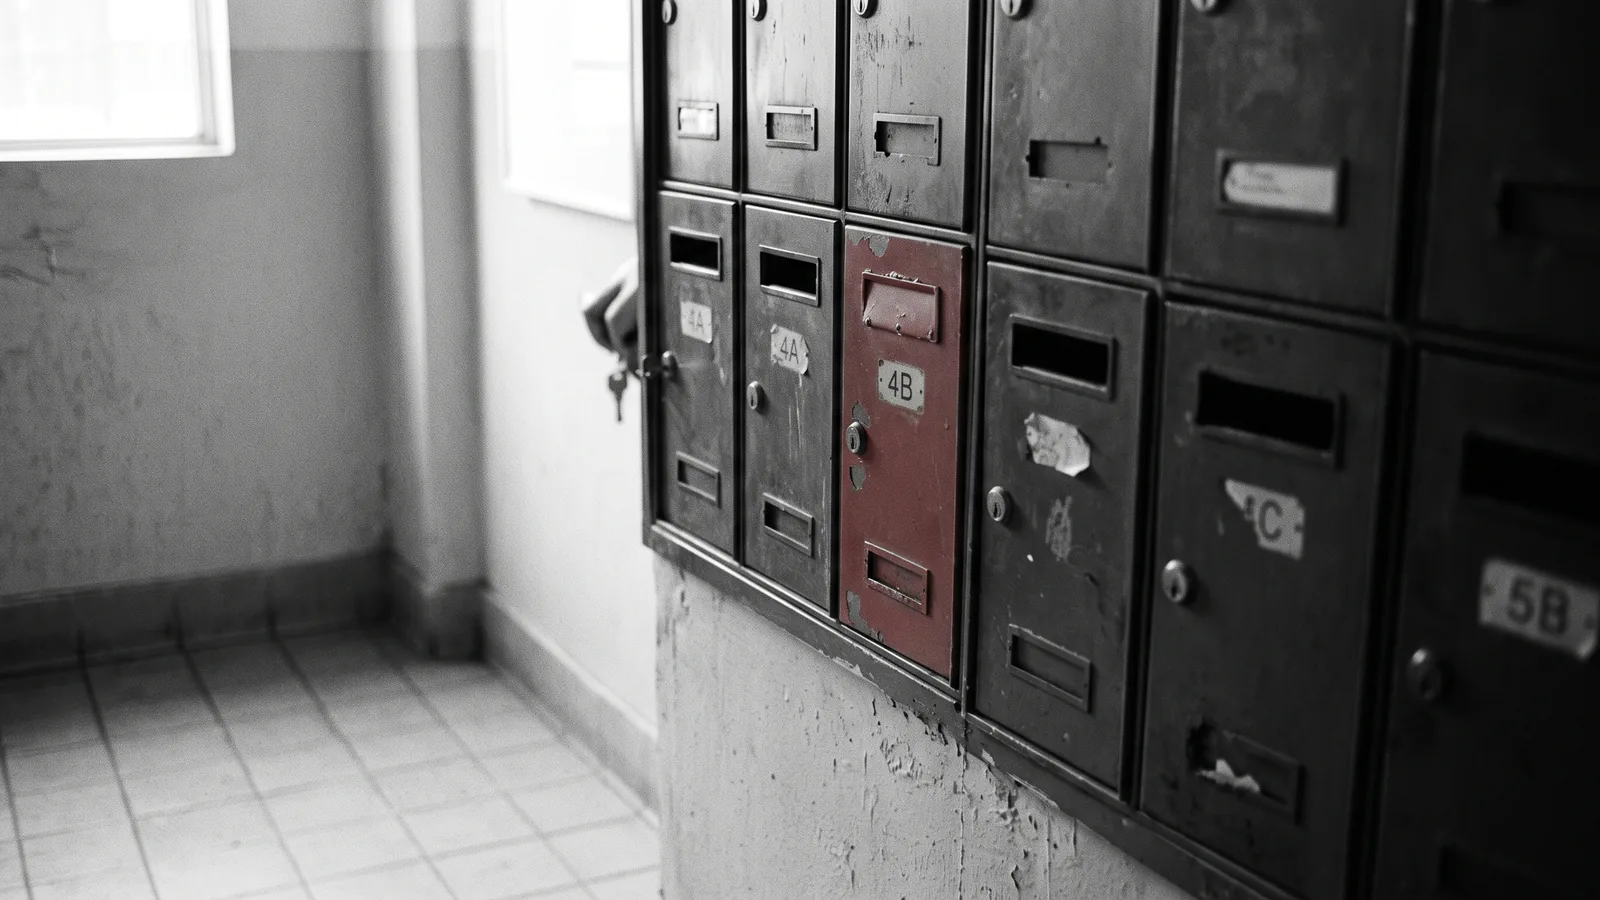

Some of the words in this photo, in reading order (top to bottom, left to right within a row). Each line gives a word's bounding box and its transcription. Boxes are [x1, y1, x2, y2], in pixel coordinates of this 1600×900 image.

[689, 309, 705, 335] 4A
[780, 337, 800, 364] 4A
[888, 370, 912, 401] 4B
